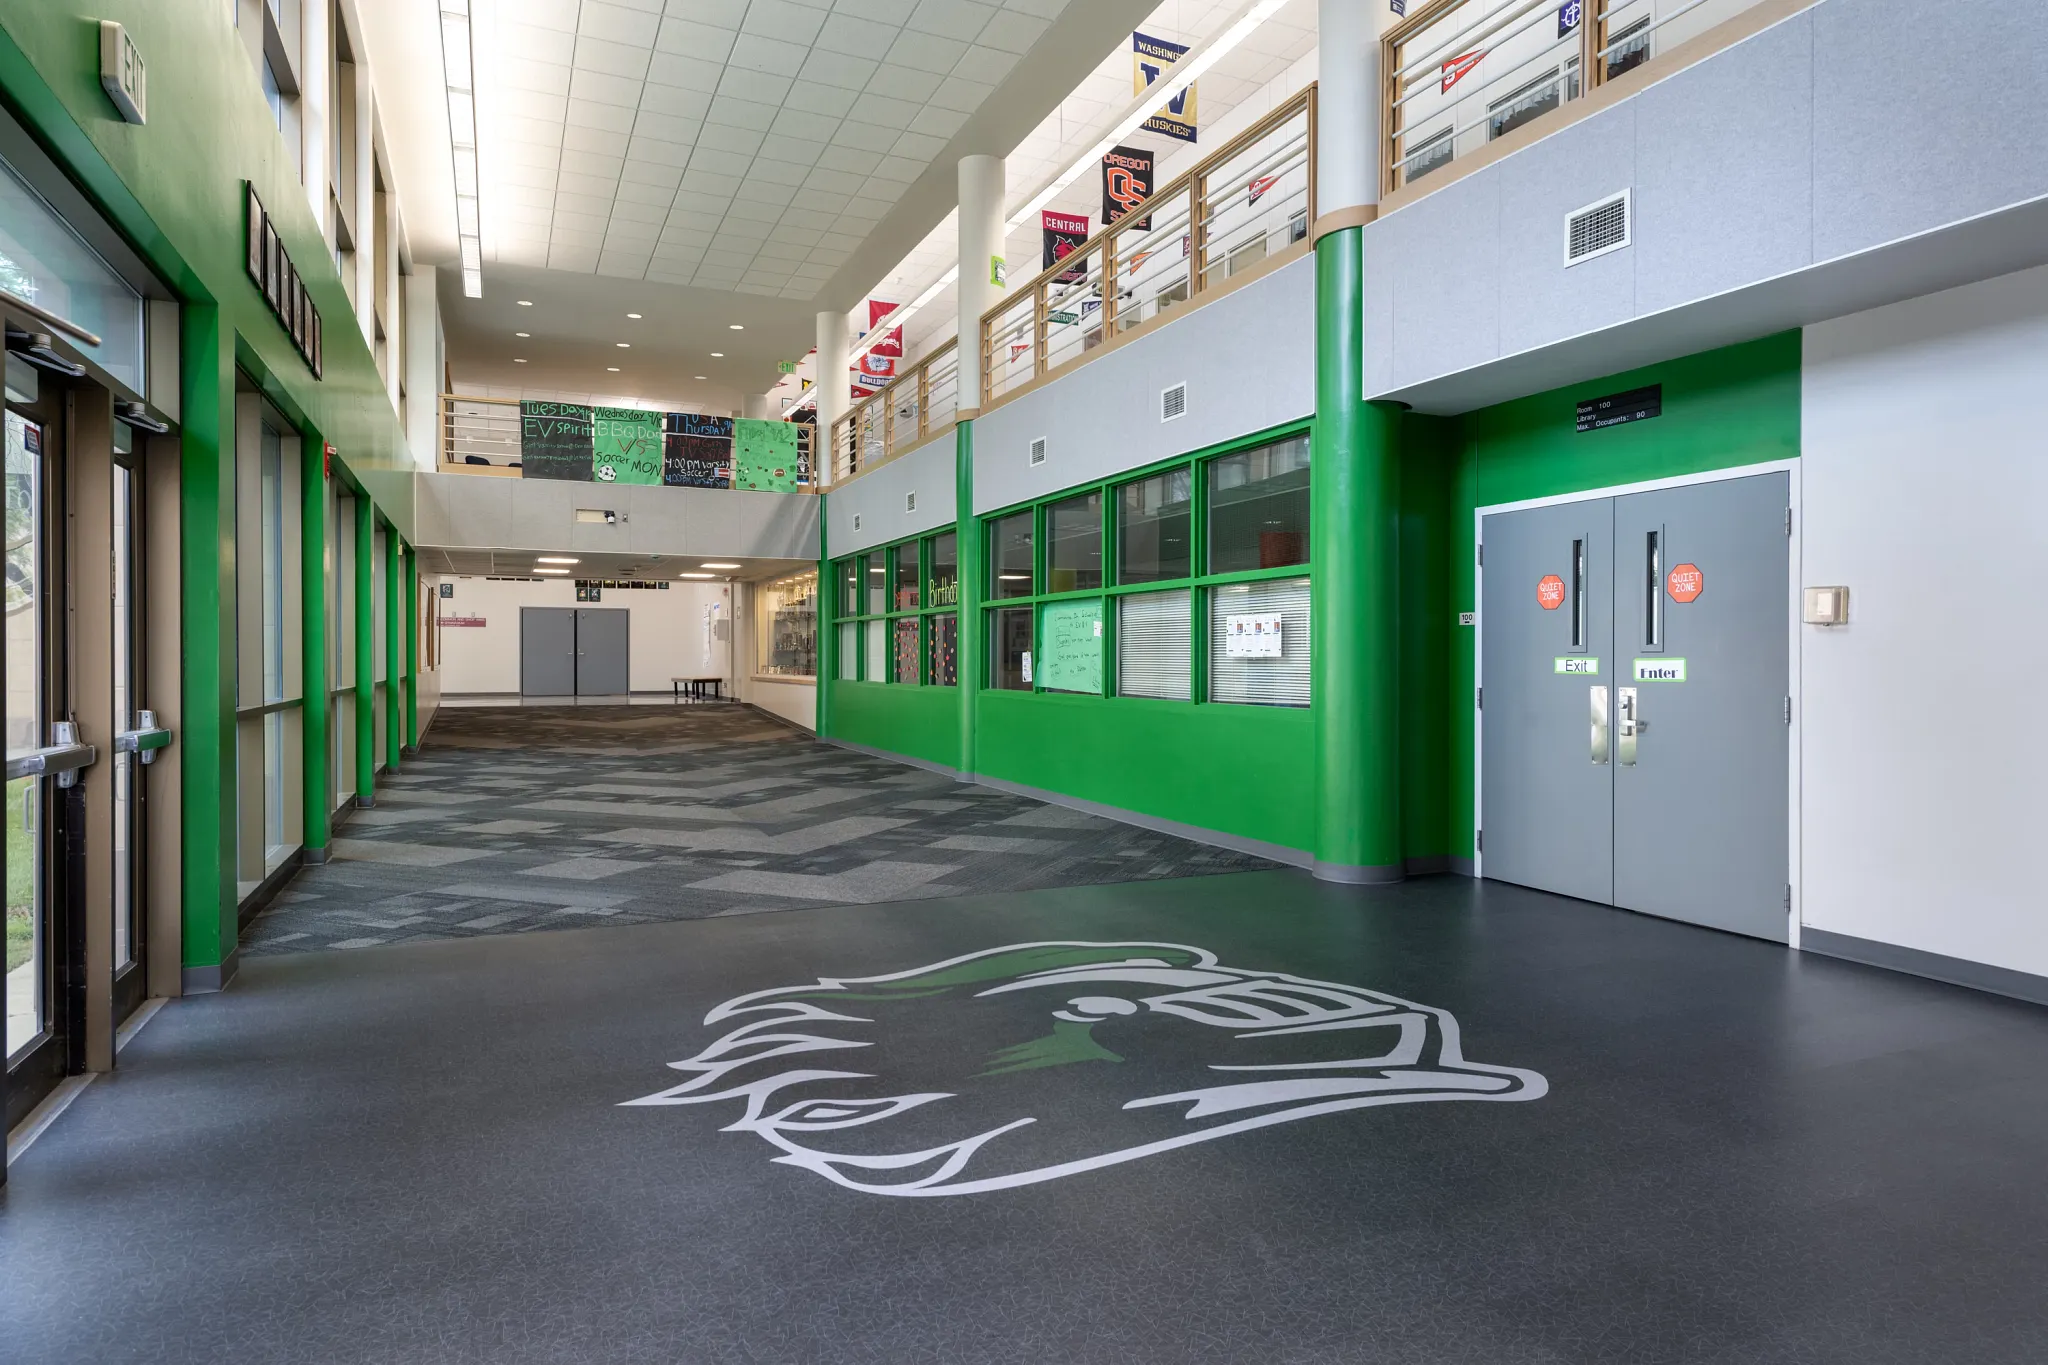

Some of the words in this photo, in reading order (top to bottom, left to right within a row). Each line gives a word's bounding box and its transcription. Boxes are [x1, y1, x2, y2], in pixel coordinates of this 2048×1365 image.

[125, 33, 144, 115] EXIT
[1144, 118, 1188, 137] HUSKIES
[1104, 152, 1150, 172] OREGON
[1046, 216, 1086, 233] CENTRAL
[781, 362, 794, 373] EXIT
[594, 406, 645, 420] Wednesday
[1577, 406, 1592, 414] Room
[1599, 401, 1611, 409] 100
[1577, 413, 1596, 423] Library
[524, 418, 554, 438] EV
[595, 451, 630, 465] Soccer
[665, 458, 686, 469] 4:00
[687, 460, 700, 470] PM
[1671, 572, 1700, 584] QUIET
[1540, 582, 1563, 592] QUIET
[1675, 582, 1696, 593] ZONE
[1543, 592, 1559, 601] ZONE
[1461, 613, 1473, 621] 100
[1565, 659, 1588, 672] Exit
[1640, 668, 1679, 679] Enter
